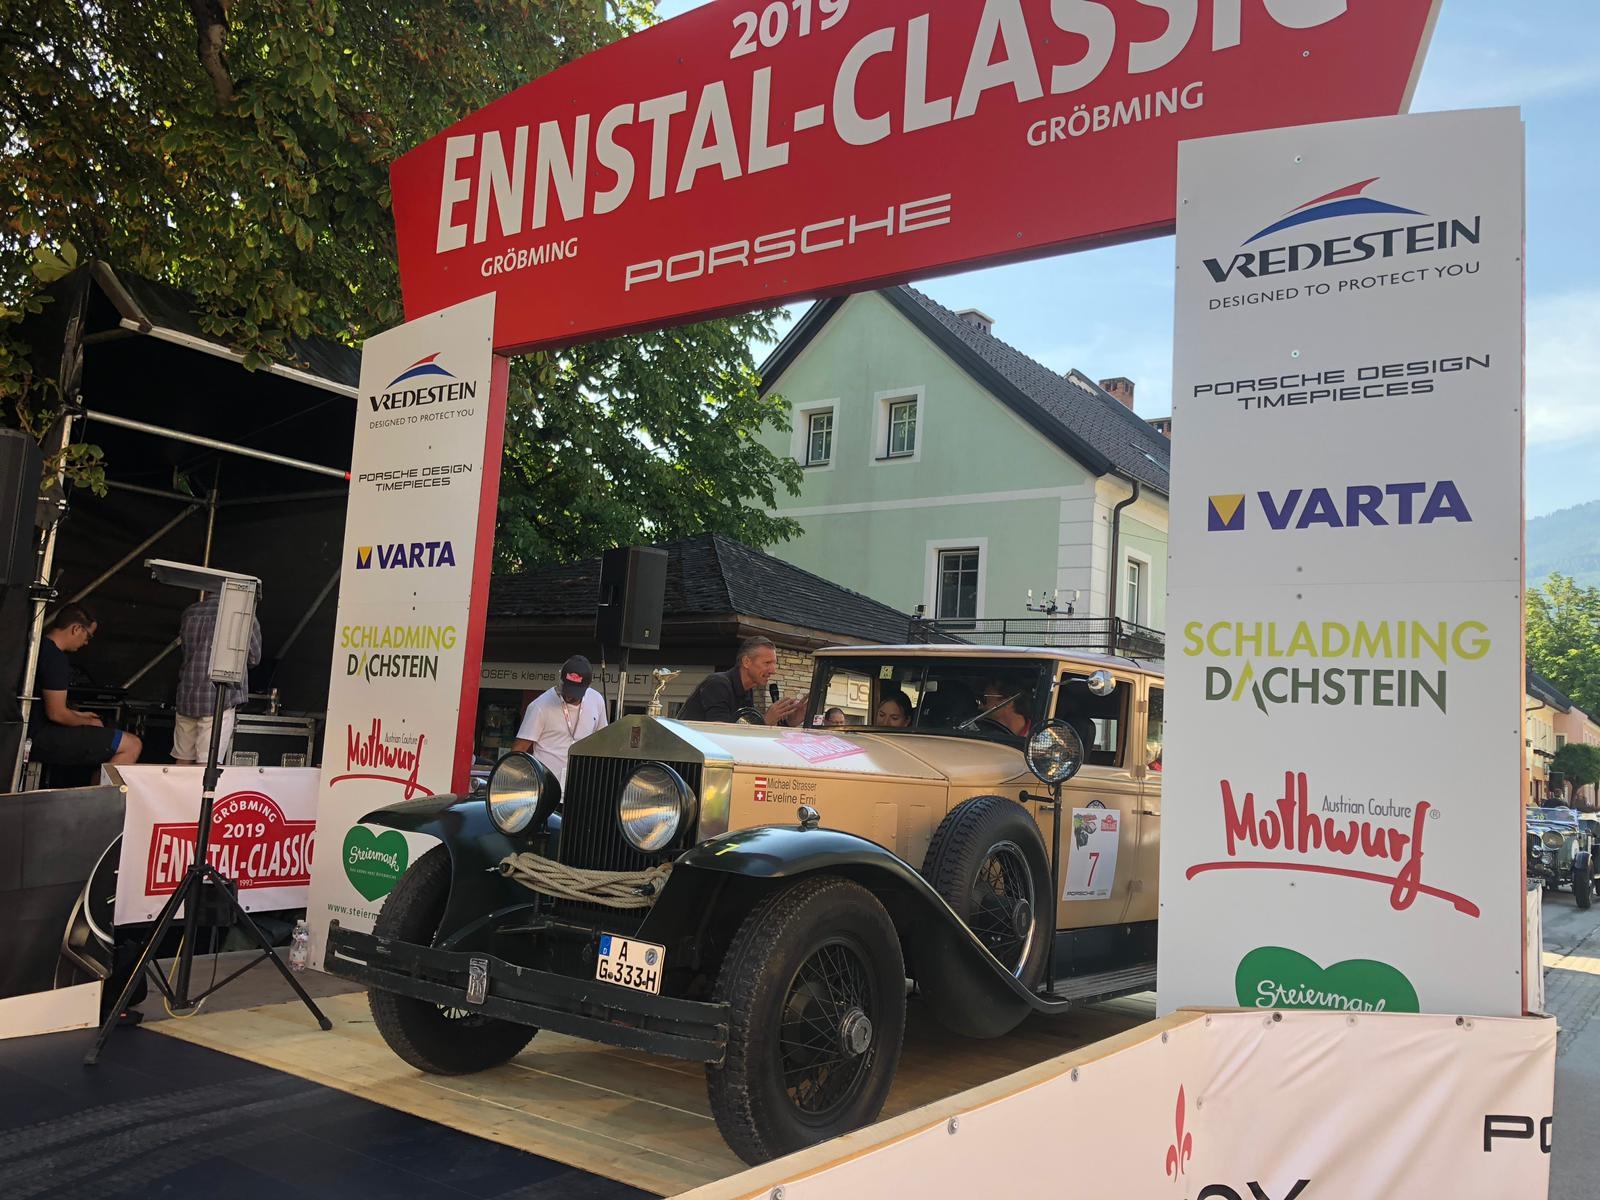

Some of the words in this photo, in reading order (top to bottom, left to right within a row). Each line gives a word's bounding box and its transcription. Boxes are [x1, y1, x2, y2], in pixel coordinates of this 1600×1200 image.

[730, 0, 848, 58] 2019
[437, 0, 1347, 253] ENNSTAL-CLASS
[1027, 82, 1204, 146] GRÖBMING
[481, 237, 578, 278] GRÖBMING
[625, 193, 951, 291] PORSCHE
[1203, 216, 1481, 282] VREDESTEIN
[1209, 287, 1298, 310] DESIGNED
[1305, 283, 1330, 297] TO
[1339, 269, 1429, 292] PROTECT
[1435, 261, 1480, 279] YOU
[1194, 370, 1345, 397] PORSCHE
[1358, 355, 1490, 381] DESIGN
[370, 381, 477, 412] VREDESTEIN
[1237, 379, 1434, 410] TIMEPIECES
[370, 417, 405, 429] DESIGNED
[408, 414, 418, 424] TO
[420, 410, 455, 422] PROTECT
[457, 408, 474, 417] YOU
[359, 468, 418, 483] PORSCHE
[422, 464, 473, 477] DESIGN
[375, 477, 451, 492] TIMEPIECES
[1257, 480, 1473, 530] VARTA
[377, 541, 456, 569] VARTA
[341, 625, 456, 651] SCHLADMING
[1183, 620, 1491, 665] SCHLADMING
[347, 651, 438, 684] DACHSTEIN
[481, 669, 518, 680] OSEF's
[521, 669, 556, 681] kleines
[1206, 660, 1447, 716] DACHSTEIN
[347, 718, 425, 800] Mothwurf
[767, 791, 797, 804] Eveline
[800, 794, 816, 805] Erni
[768, 778, 790, 790] Michael
[213, 800, 277, 824] GRÖBMING
[1322, 795, 1365, 816] Austrian
[1368, 798, 1412, 818] Couture
[223, 823, 265, 839] 2019
[1220, 771, 1431, 911] Mothwurf
[156, 830, 316, 884] ENNTAL-CLASSIC
[349, 846, 399, 872] Steiermark
[1089, 853, 1099, 887] 7
[619, 941, 628, 961] A
[1484, 1115, 1553, 1154] P
